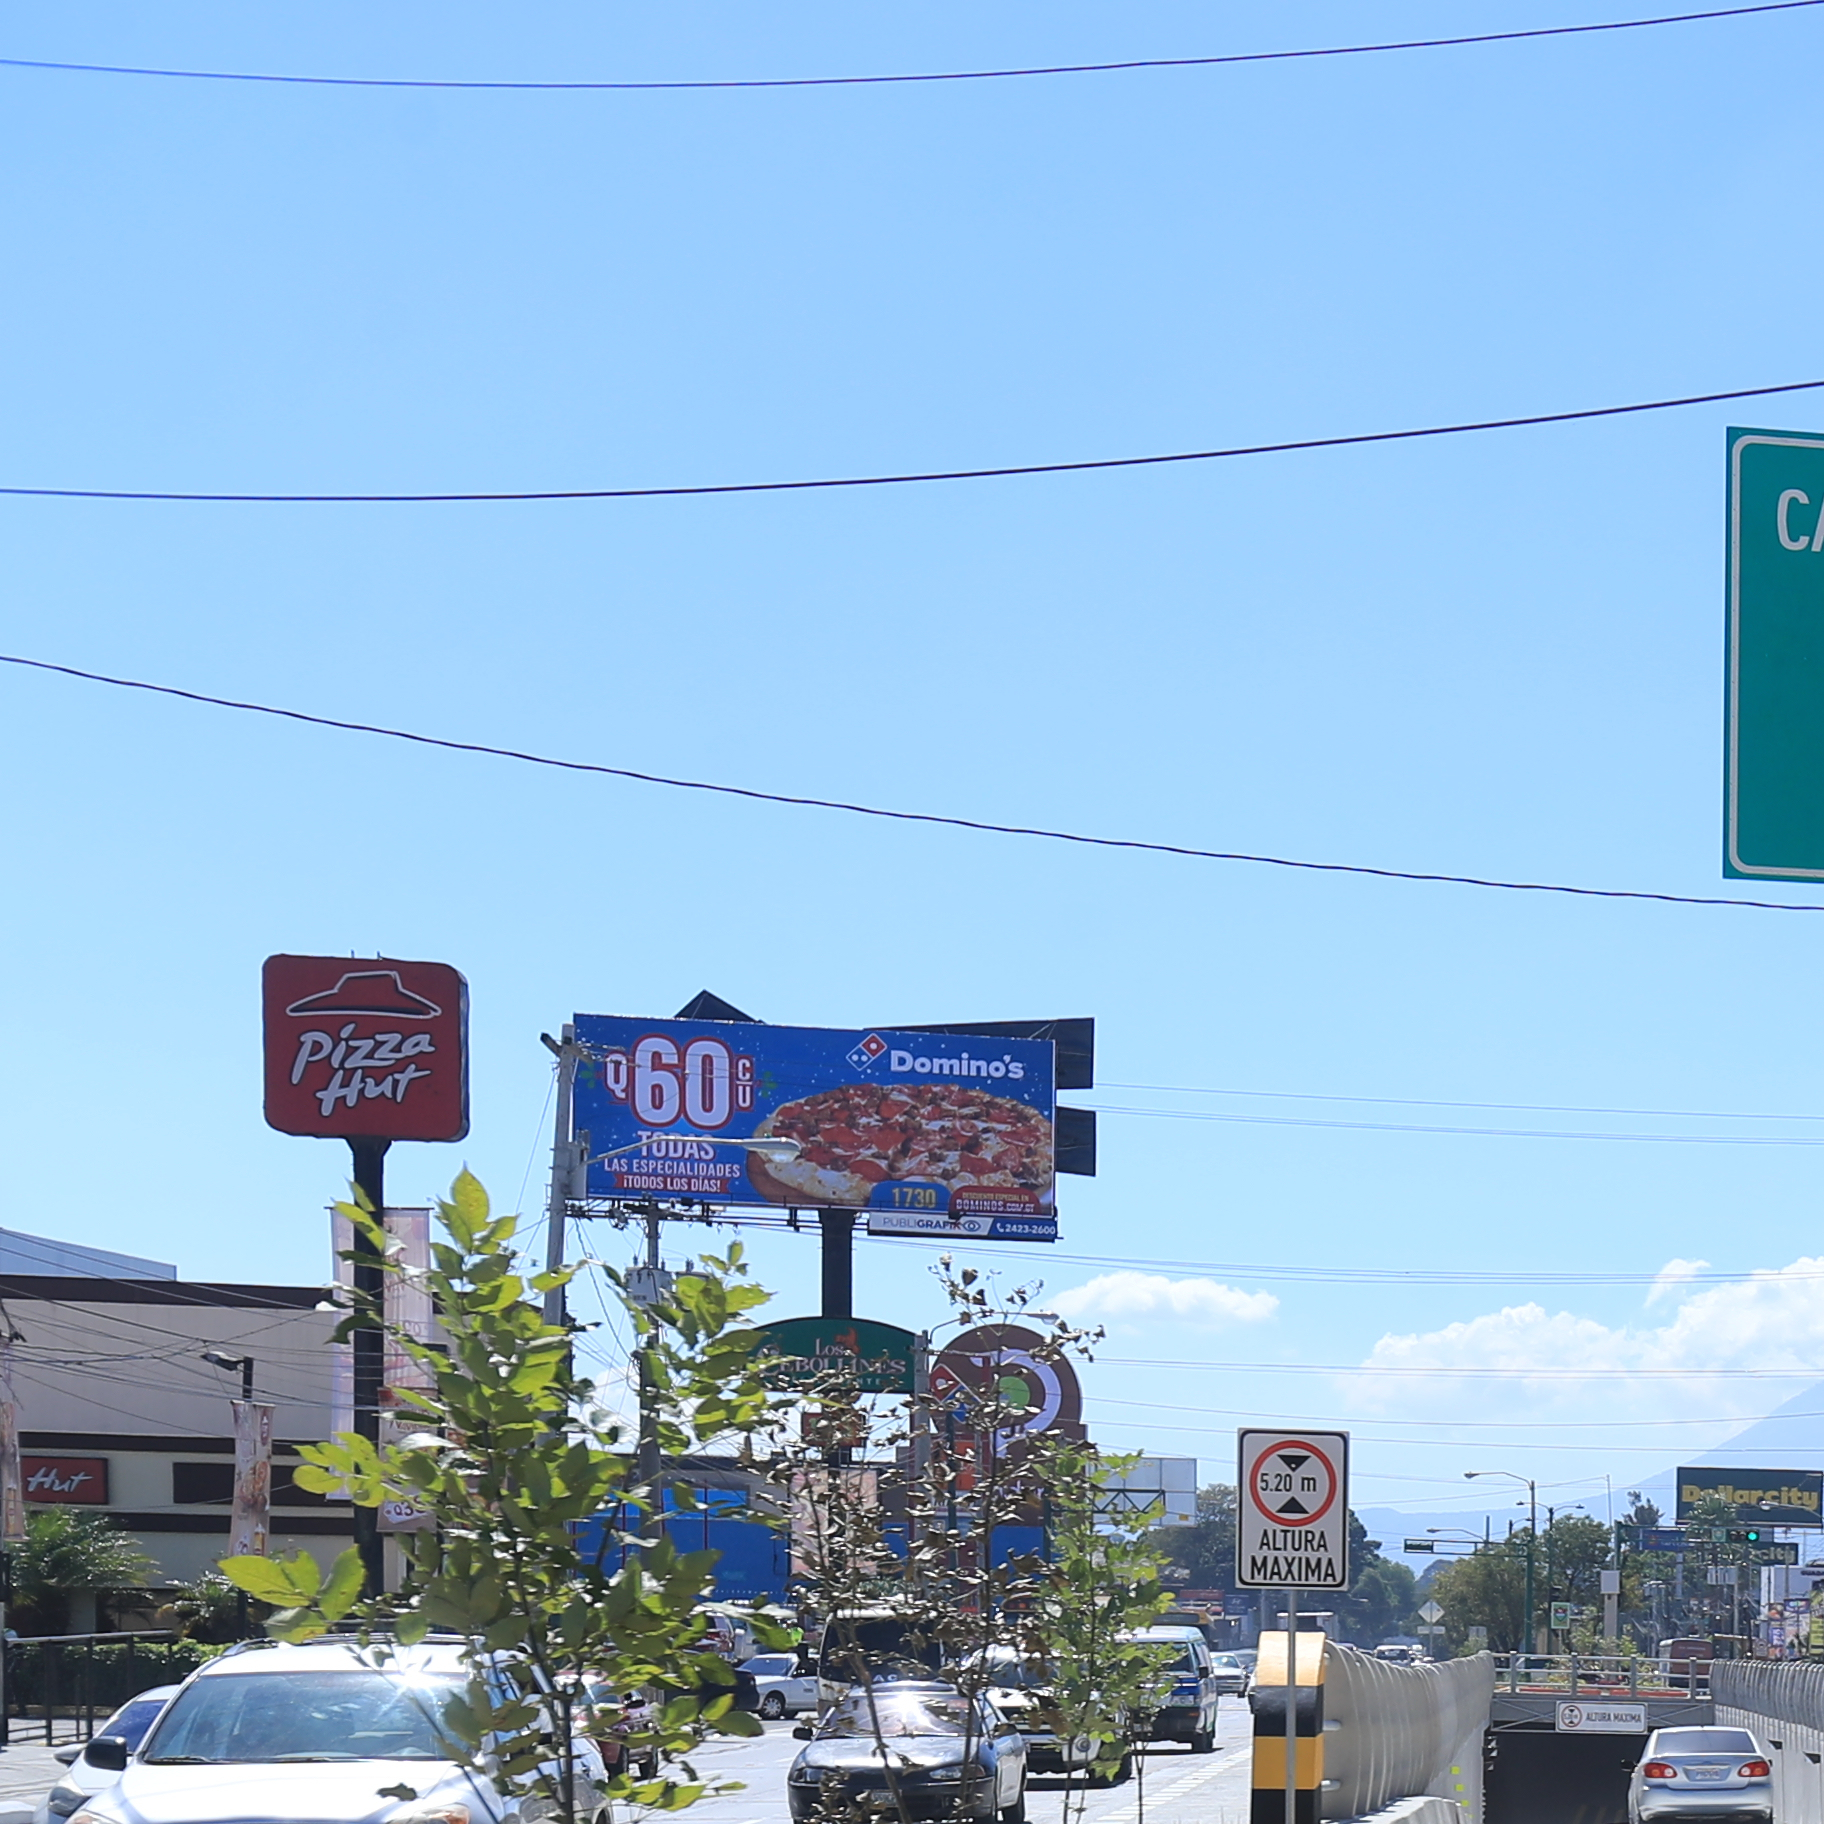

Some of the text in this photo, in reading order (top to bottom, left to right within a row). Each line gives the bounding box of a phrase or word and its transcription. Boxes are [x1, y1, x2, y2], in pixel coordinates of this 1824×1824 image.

[291, 1022, 436, 1085] Pizza
[890, 1048, 1026, 1080] Domino's
[315, 1062, 432, 1117] Hut
[637, 1130, 715, 1160] TODAS
[604, 1158, 741, 1178] LAS ESPECIALIDADES
[666, 1177, 688, 1191] LOS
[892, 1186, 937, 1209] 1730
[1005, 1223, 1056, 1235] 2423-2600
[815, 1338, 845, 1357] Los
[26, 1466, 94, 1492] Hut
[1260, 1472, 1316, 1492] 5.20 m
[1259, 1529, 1329, 1552] ALTURA
[1250, 1555, 1337, 1583] MAXIMA
[1586, 1712, 1612, 1722] ALTURA
[1613, 1712, 1642, 1723] MAXIMA
